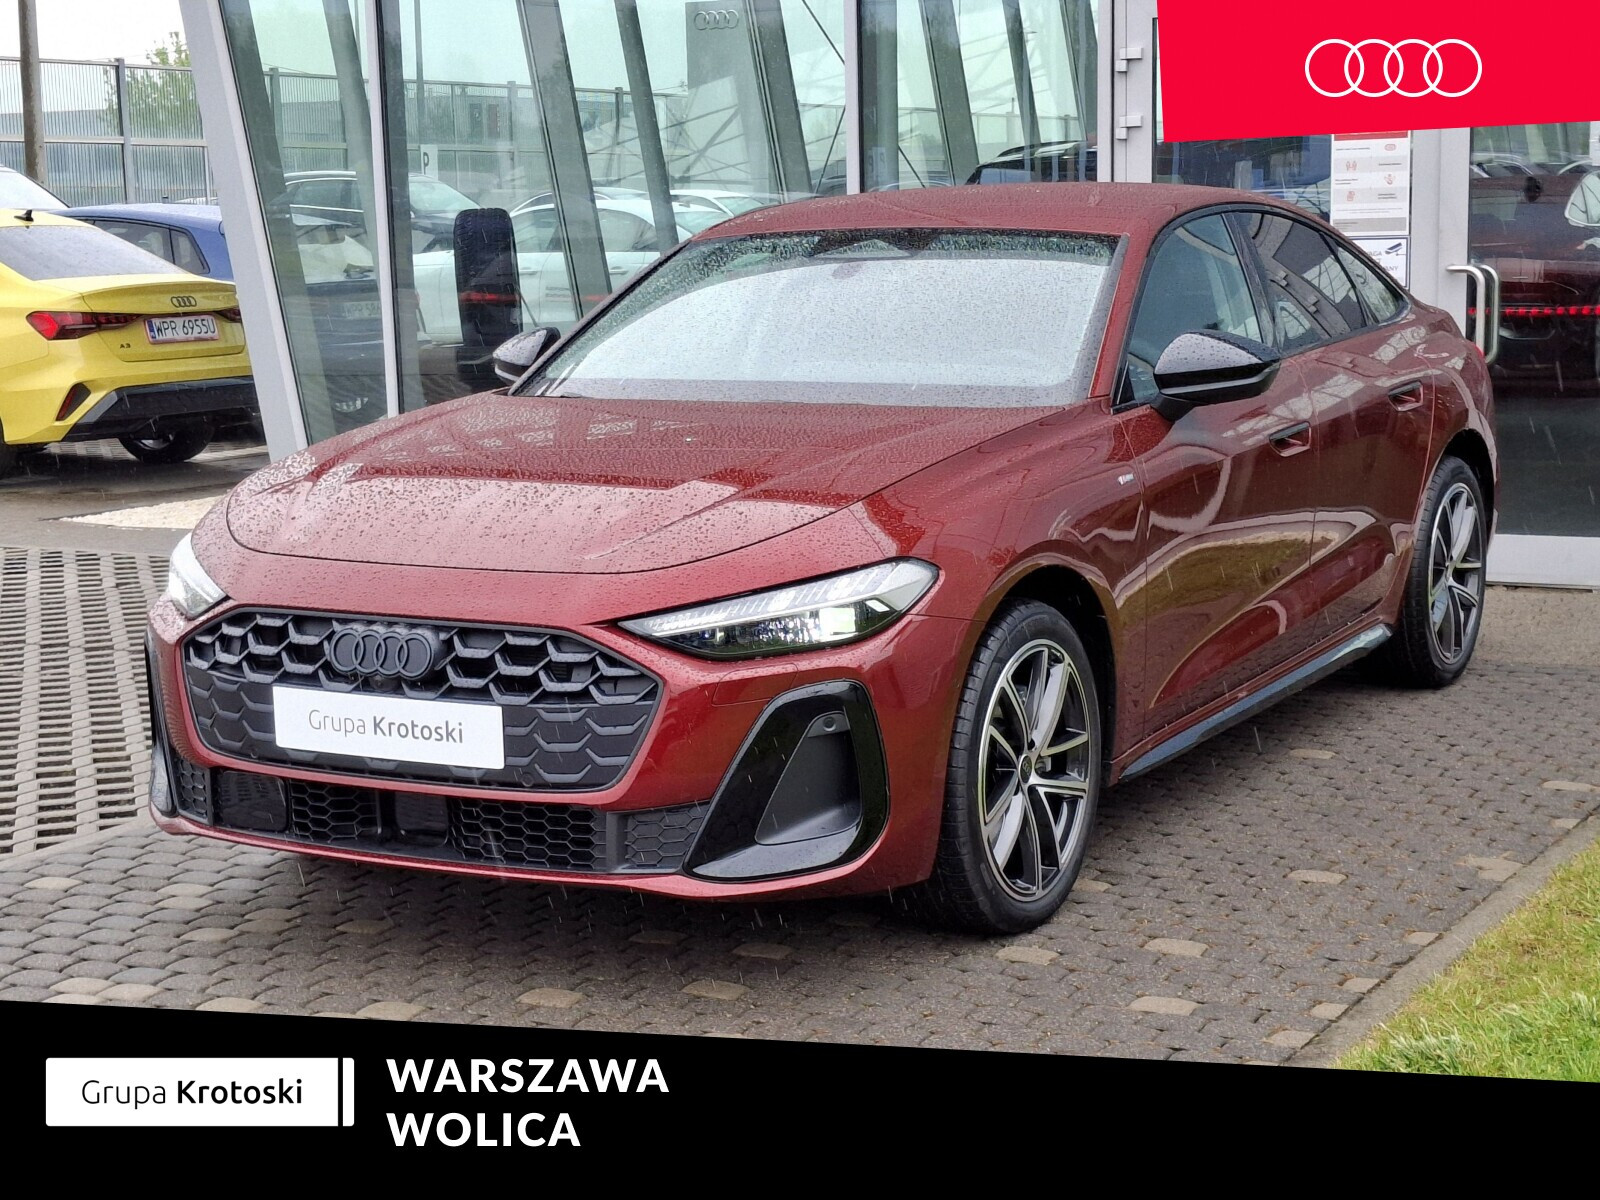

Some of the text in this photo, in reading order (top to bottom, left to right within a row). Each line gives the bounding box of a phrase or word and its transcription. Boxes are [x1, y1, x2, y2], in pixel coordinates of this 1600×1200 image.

[154, 320, 179, 338] WPR
[308, 709, 463, 744] Grupa Krotoski
